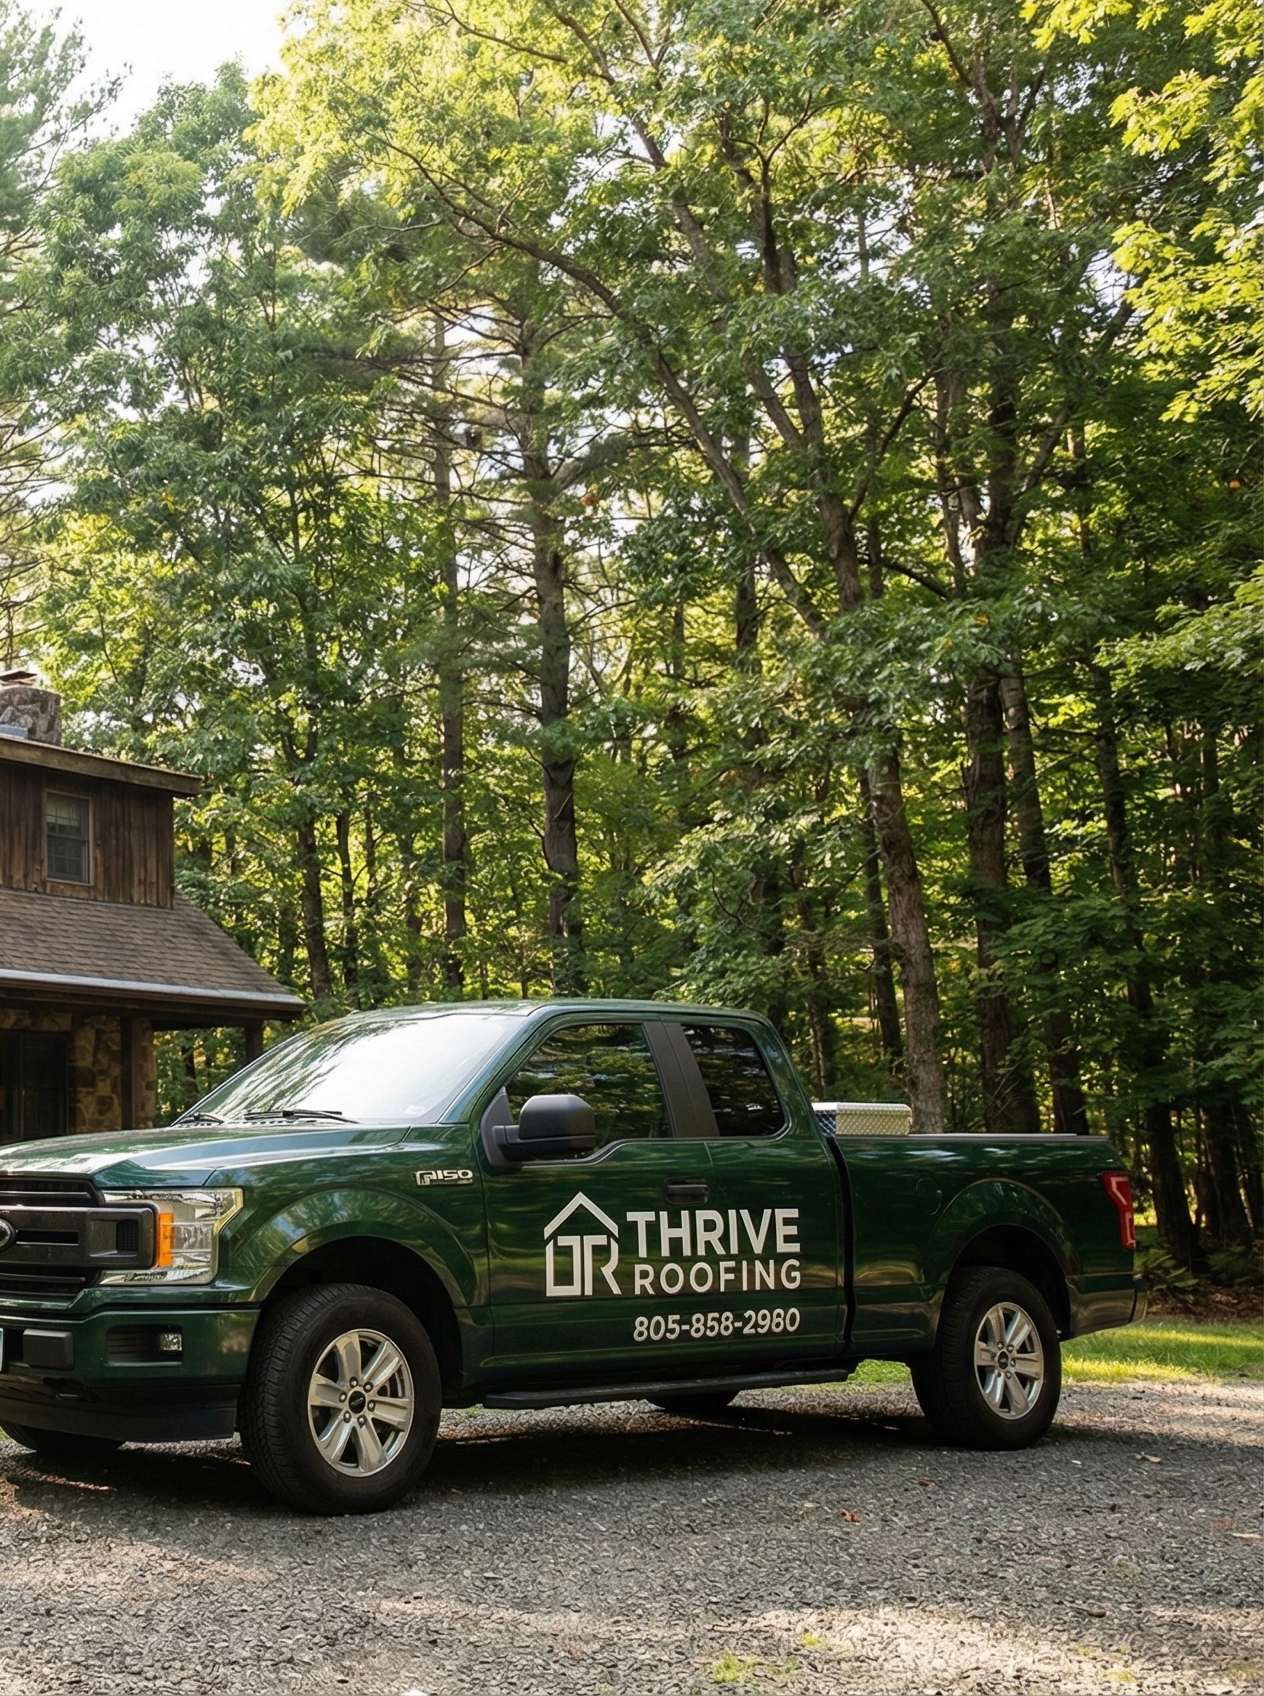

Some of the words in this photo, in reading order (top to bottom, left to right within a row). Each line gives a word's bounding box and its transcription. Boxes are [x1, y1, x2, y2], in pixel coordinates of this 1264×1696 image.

[626, 1208, 801, 1258] THRIVE
[634, 1258, 801, 1295] ROOFING
[633, 1307, 801, 1342] 805-858-2980
